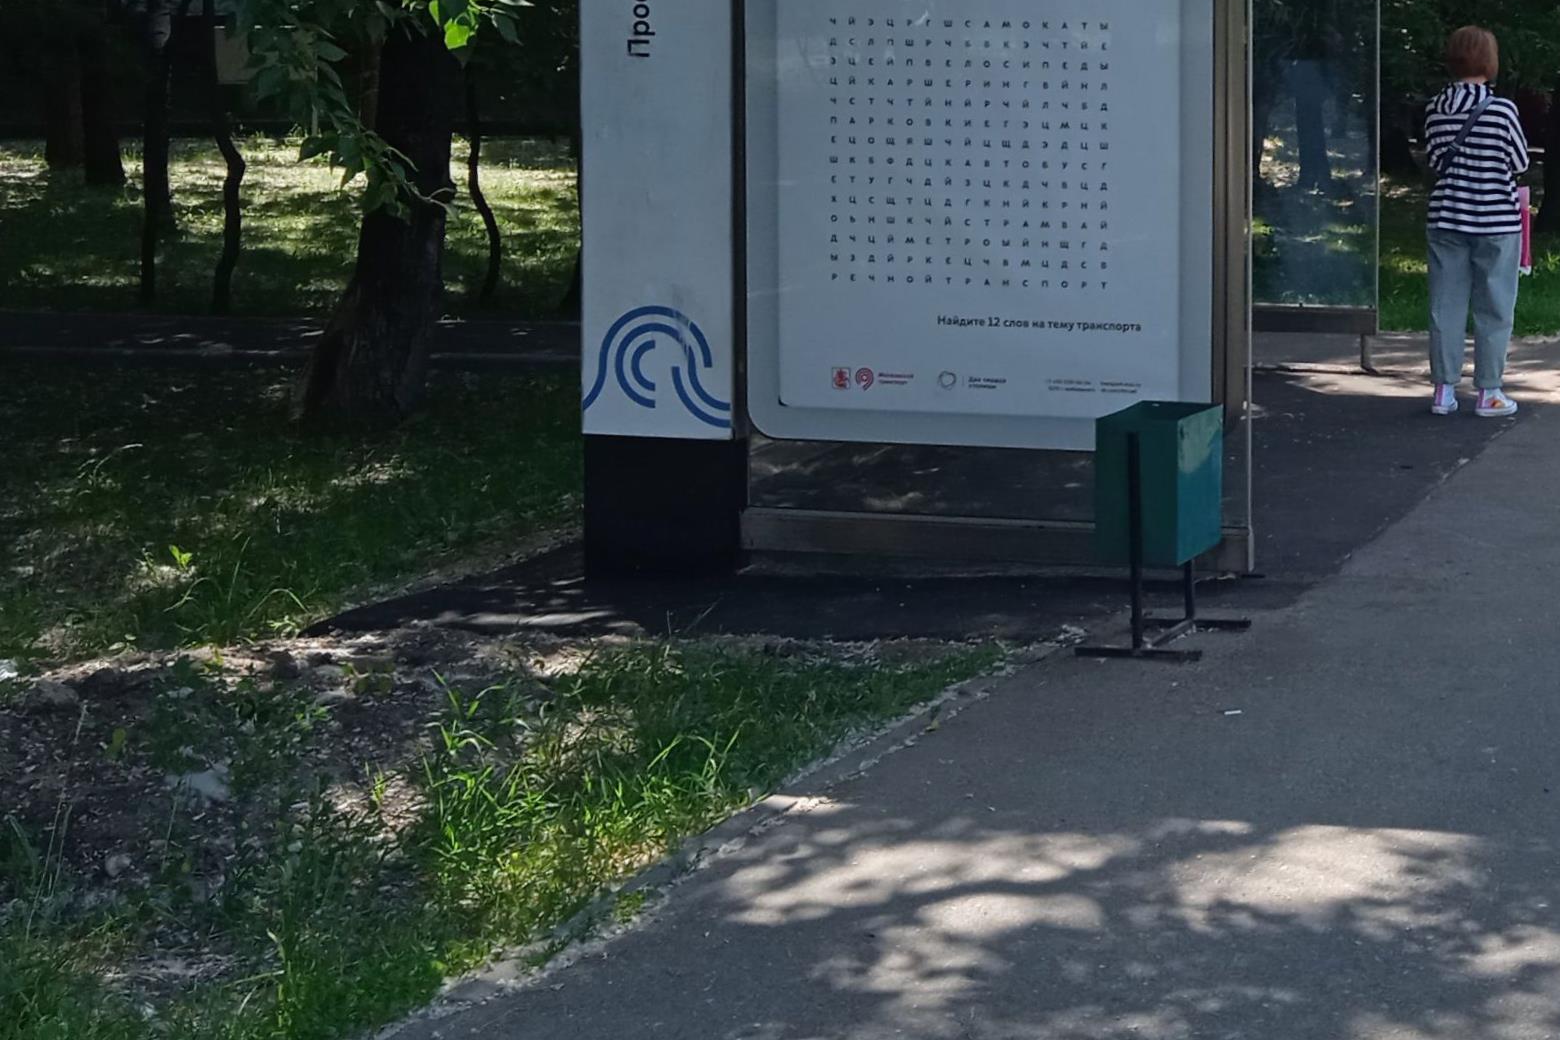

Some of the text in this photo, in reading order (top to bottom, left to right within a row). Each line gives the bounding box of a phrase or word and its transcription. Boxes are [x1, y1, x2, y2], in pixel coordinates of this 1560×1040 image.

[937, 315, 1142, 334] Найдите 12 слов на тему транспорта
